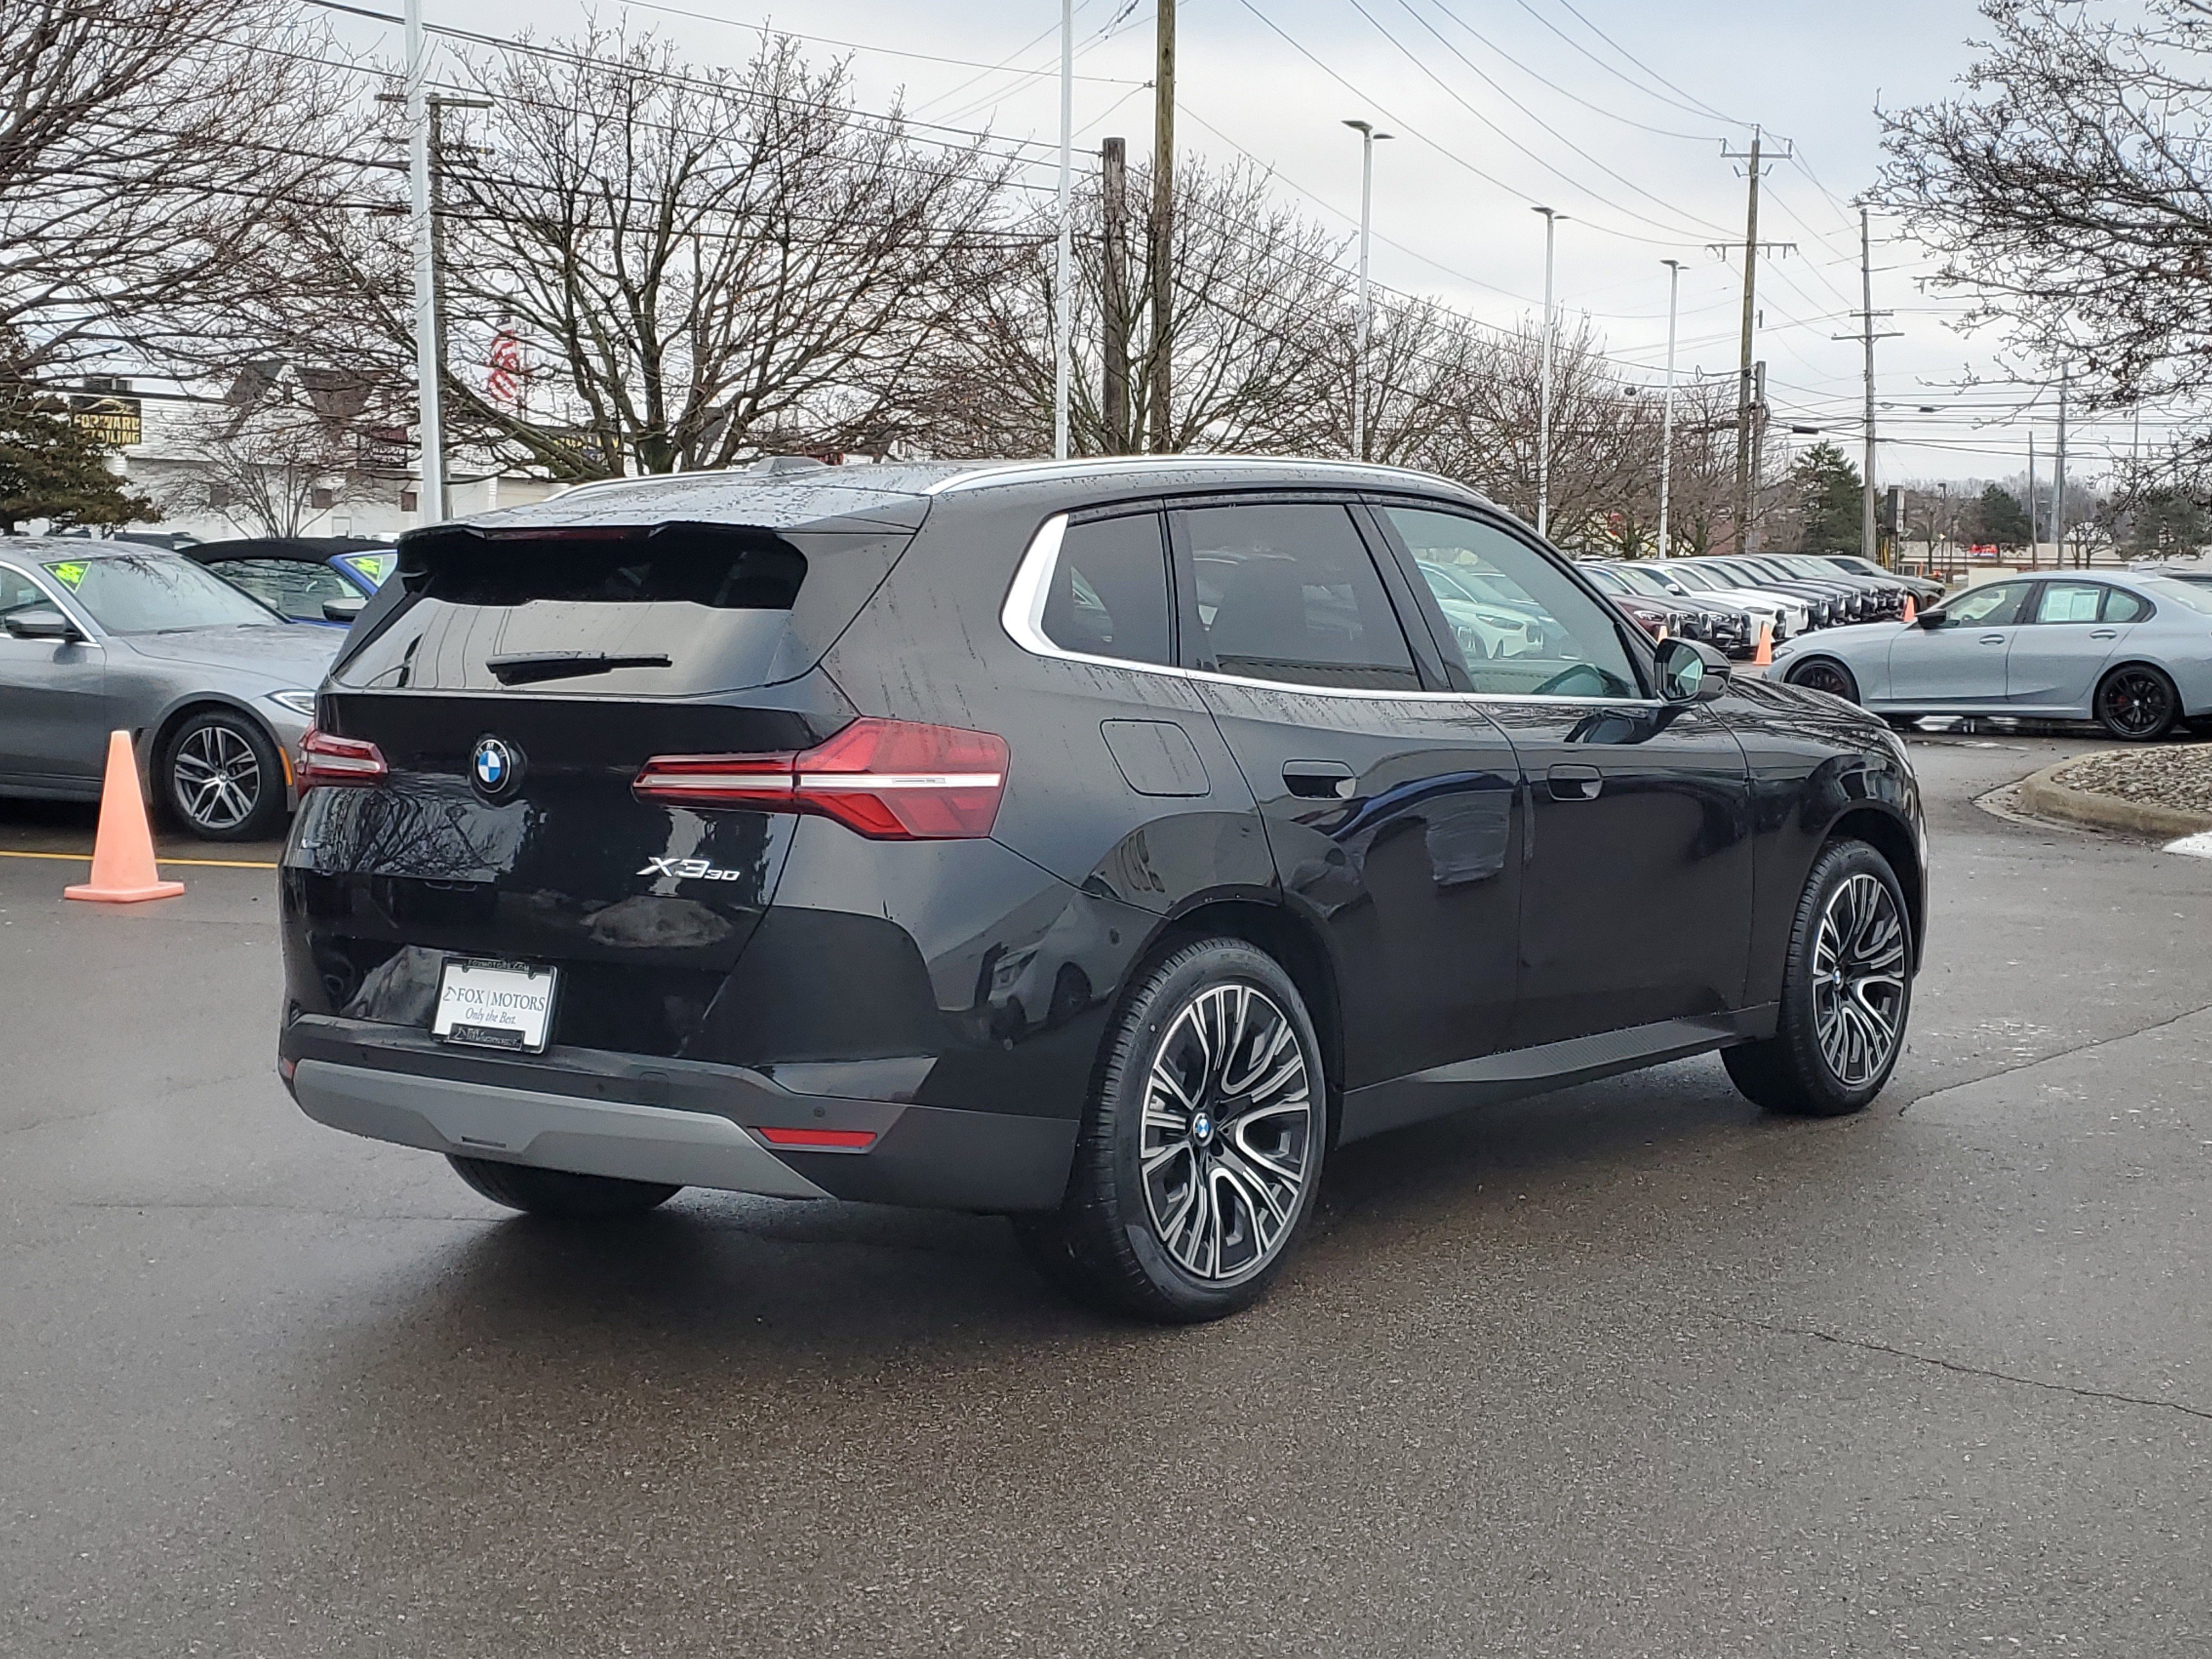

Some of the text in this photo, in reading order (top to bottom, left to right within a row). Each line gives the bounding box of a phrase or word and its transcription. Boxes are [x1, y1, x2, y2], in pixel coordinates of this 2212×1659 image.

[456, 988, 545, 1012] FOX MOTORS
[465, 1007, 484, 1024] Only
[486, 1009, 498, 1022] the
